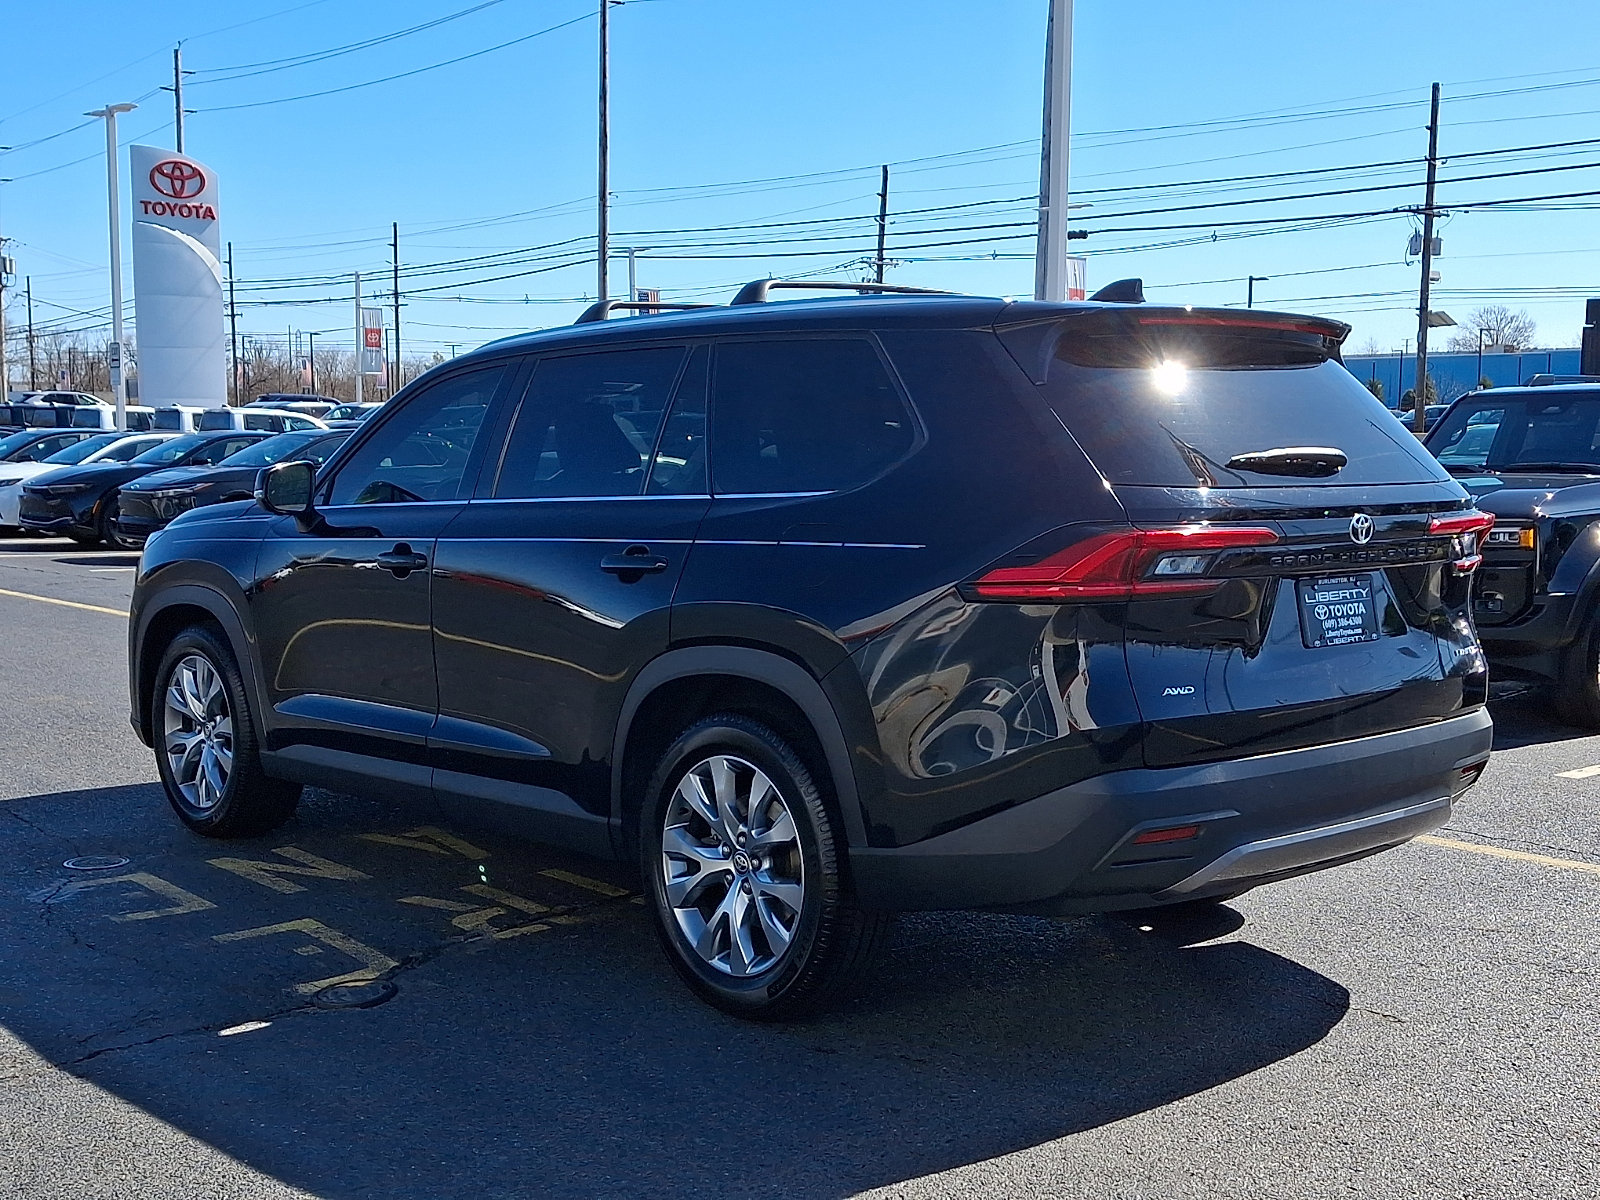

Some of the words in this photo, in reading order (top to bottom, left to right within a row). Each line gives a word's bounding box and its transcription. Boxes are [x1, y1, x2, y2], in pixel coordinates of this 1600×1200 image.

[139, 200, 217, 221] TOYOTA
[1269, 553, 1334, 567] GRAND
[1340, 545, 1436, 563] HIGHLANDER
[1304, 588, 1369, 603] LIBERTY
[1329, 602, 1366, 617] TOYOTA
[1322, 619, 1338, 630] (609)
[1327, 635, 1366, 646] LIBERTY
[1161, 686, 1195, 697] AWD
